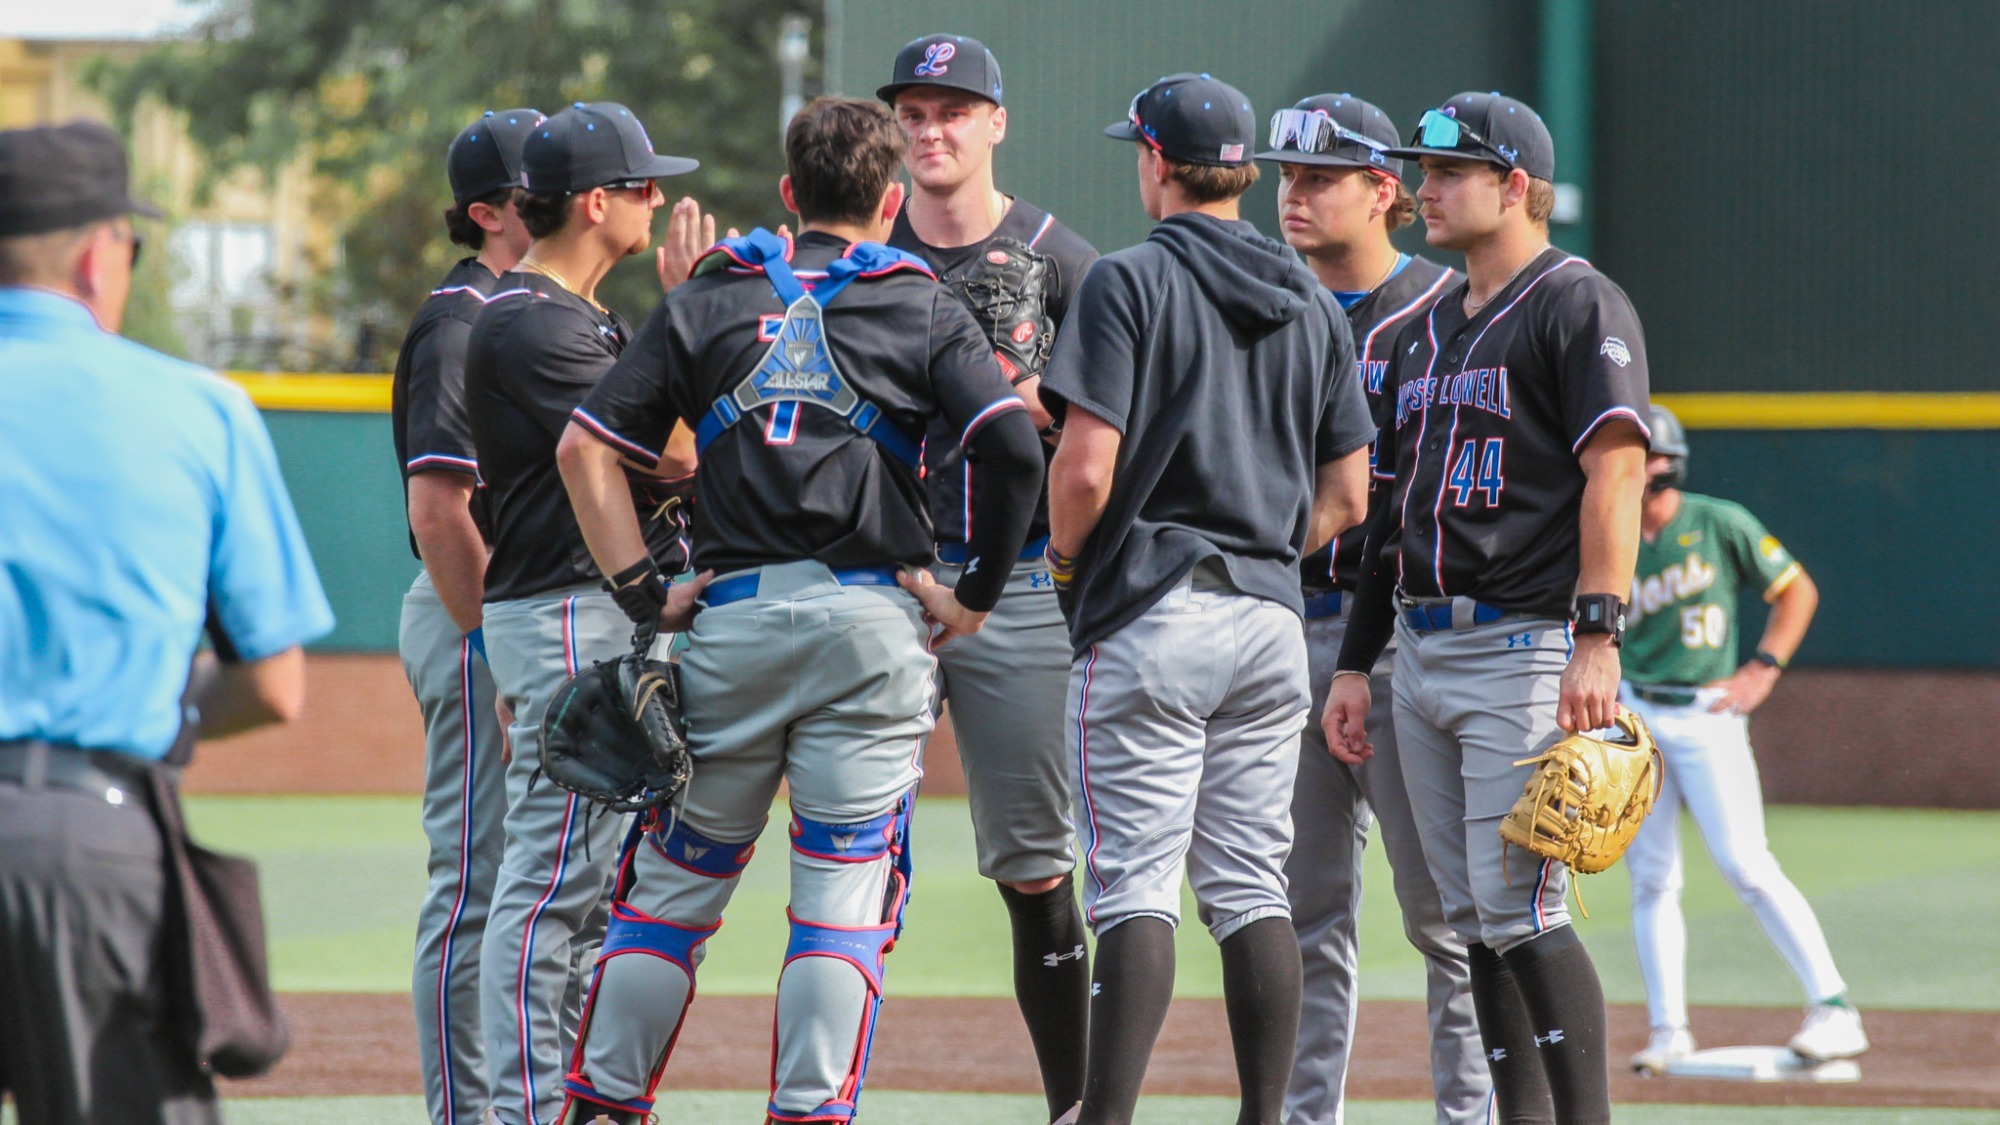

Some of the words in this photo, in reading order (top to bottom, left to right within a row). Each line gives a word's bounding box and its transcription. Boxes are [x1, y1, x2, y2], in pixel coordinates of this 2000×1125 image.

[914, 42, 956, 77] L
[763, 371, 830, 391] ALL-STAR
[1438, 366, 1511, 420] LOWELL
[1448, 437, 1504, 508] 44
[1681, 604, 1726, 649] 50
